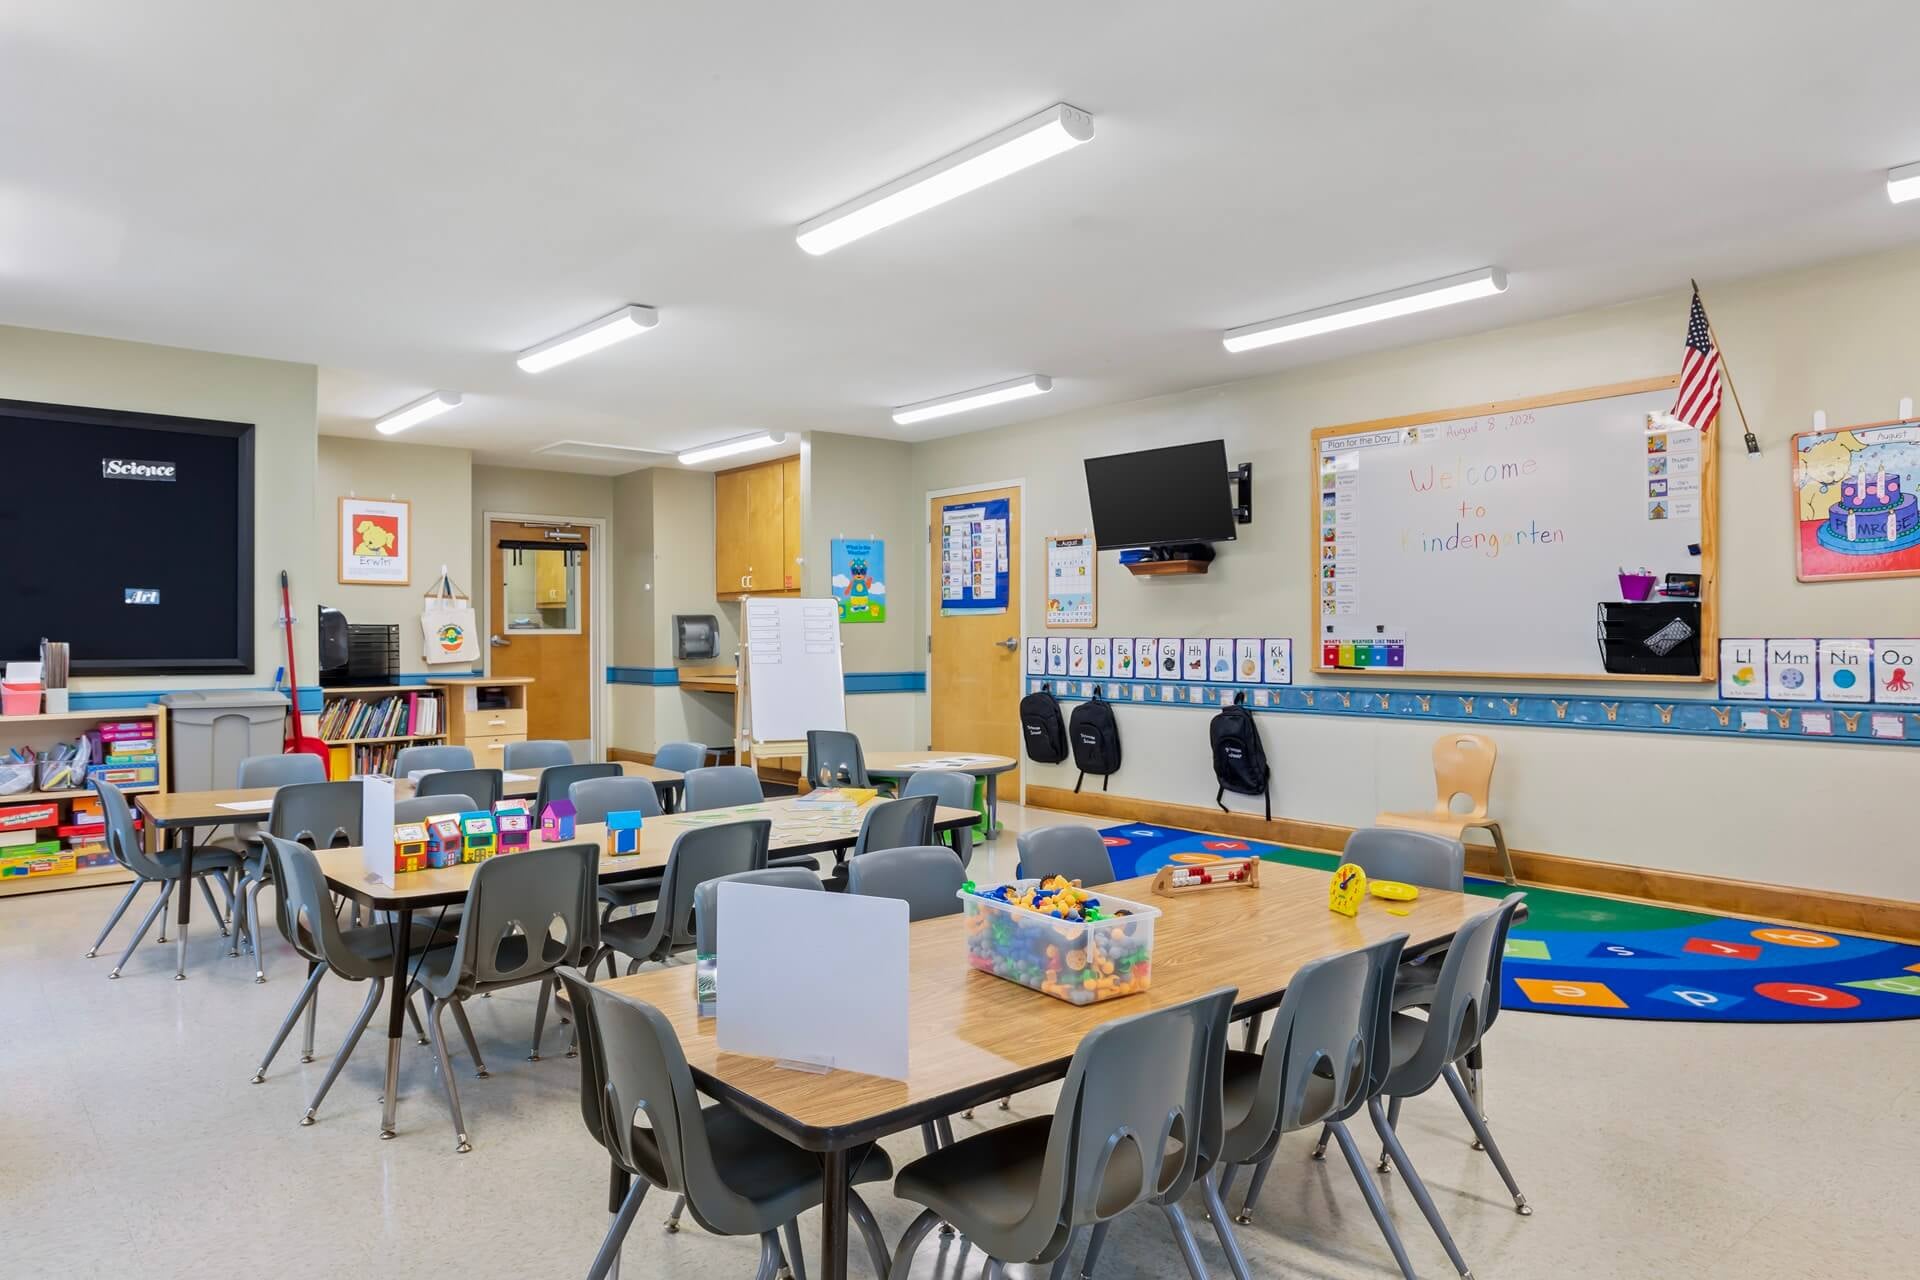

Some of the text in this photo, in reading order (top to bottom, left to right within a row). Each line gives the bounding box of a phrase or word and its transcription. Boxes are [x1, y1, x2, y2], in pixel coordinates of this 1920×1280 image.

[1446, 422, 1479, 440] August
[1487, 417, 1497, 431] 8
[1327, 434, 1391, 449] Plan for the Day
[1877, 430, 1907, 441] August
[106, 460, 175, 477] Science
[1409, 457, 1538, 493] Welcome
[1458, 501, 1488, 518] to
[1835, 516, 1915, 536] PMROSE
[359, 556, 393, 568] Erwin
[125, 590, 159, 604] Art
[1031, 645, 1041, 654] Aa
[1051, 644, 1062, 654] Bb
[1073, 645, 1084, 655] Cc
[1095, 645, 1106, 655] Dd
[1118, 645, 1128, 655] Ee
[1141, 645, 1151, 655] Ff
[1162, 645, 1176, 657] Gg
[1188, 645, 1202, 656] Hh
[1244, 646, 1252, 658] Jj
[1270, 646, 1284, 657] Kk
[1736, 648, 1751, 664] Ll
[1774, 650, 1809, 664] Mm
[1830, 650, 1858, 664] Nn
[1882, 650, 1913, 665] Oo
